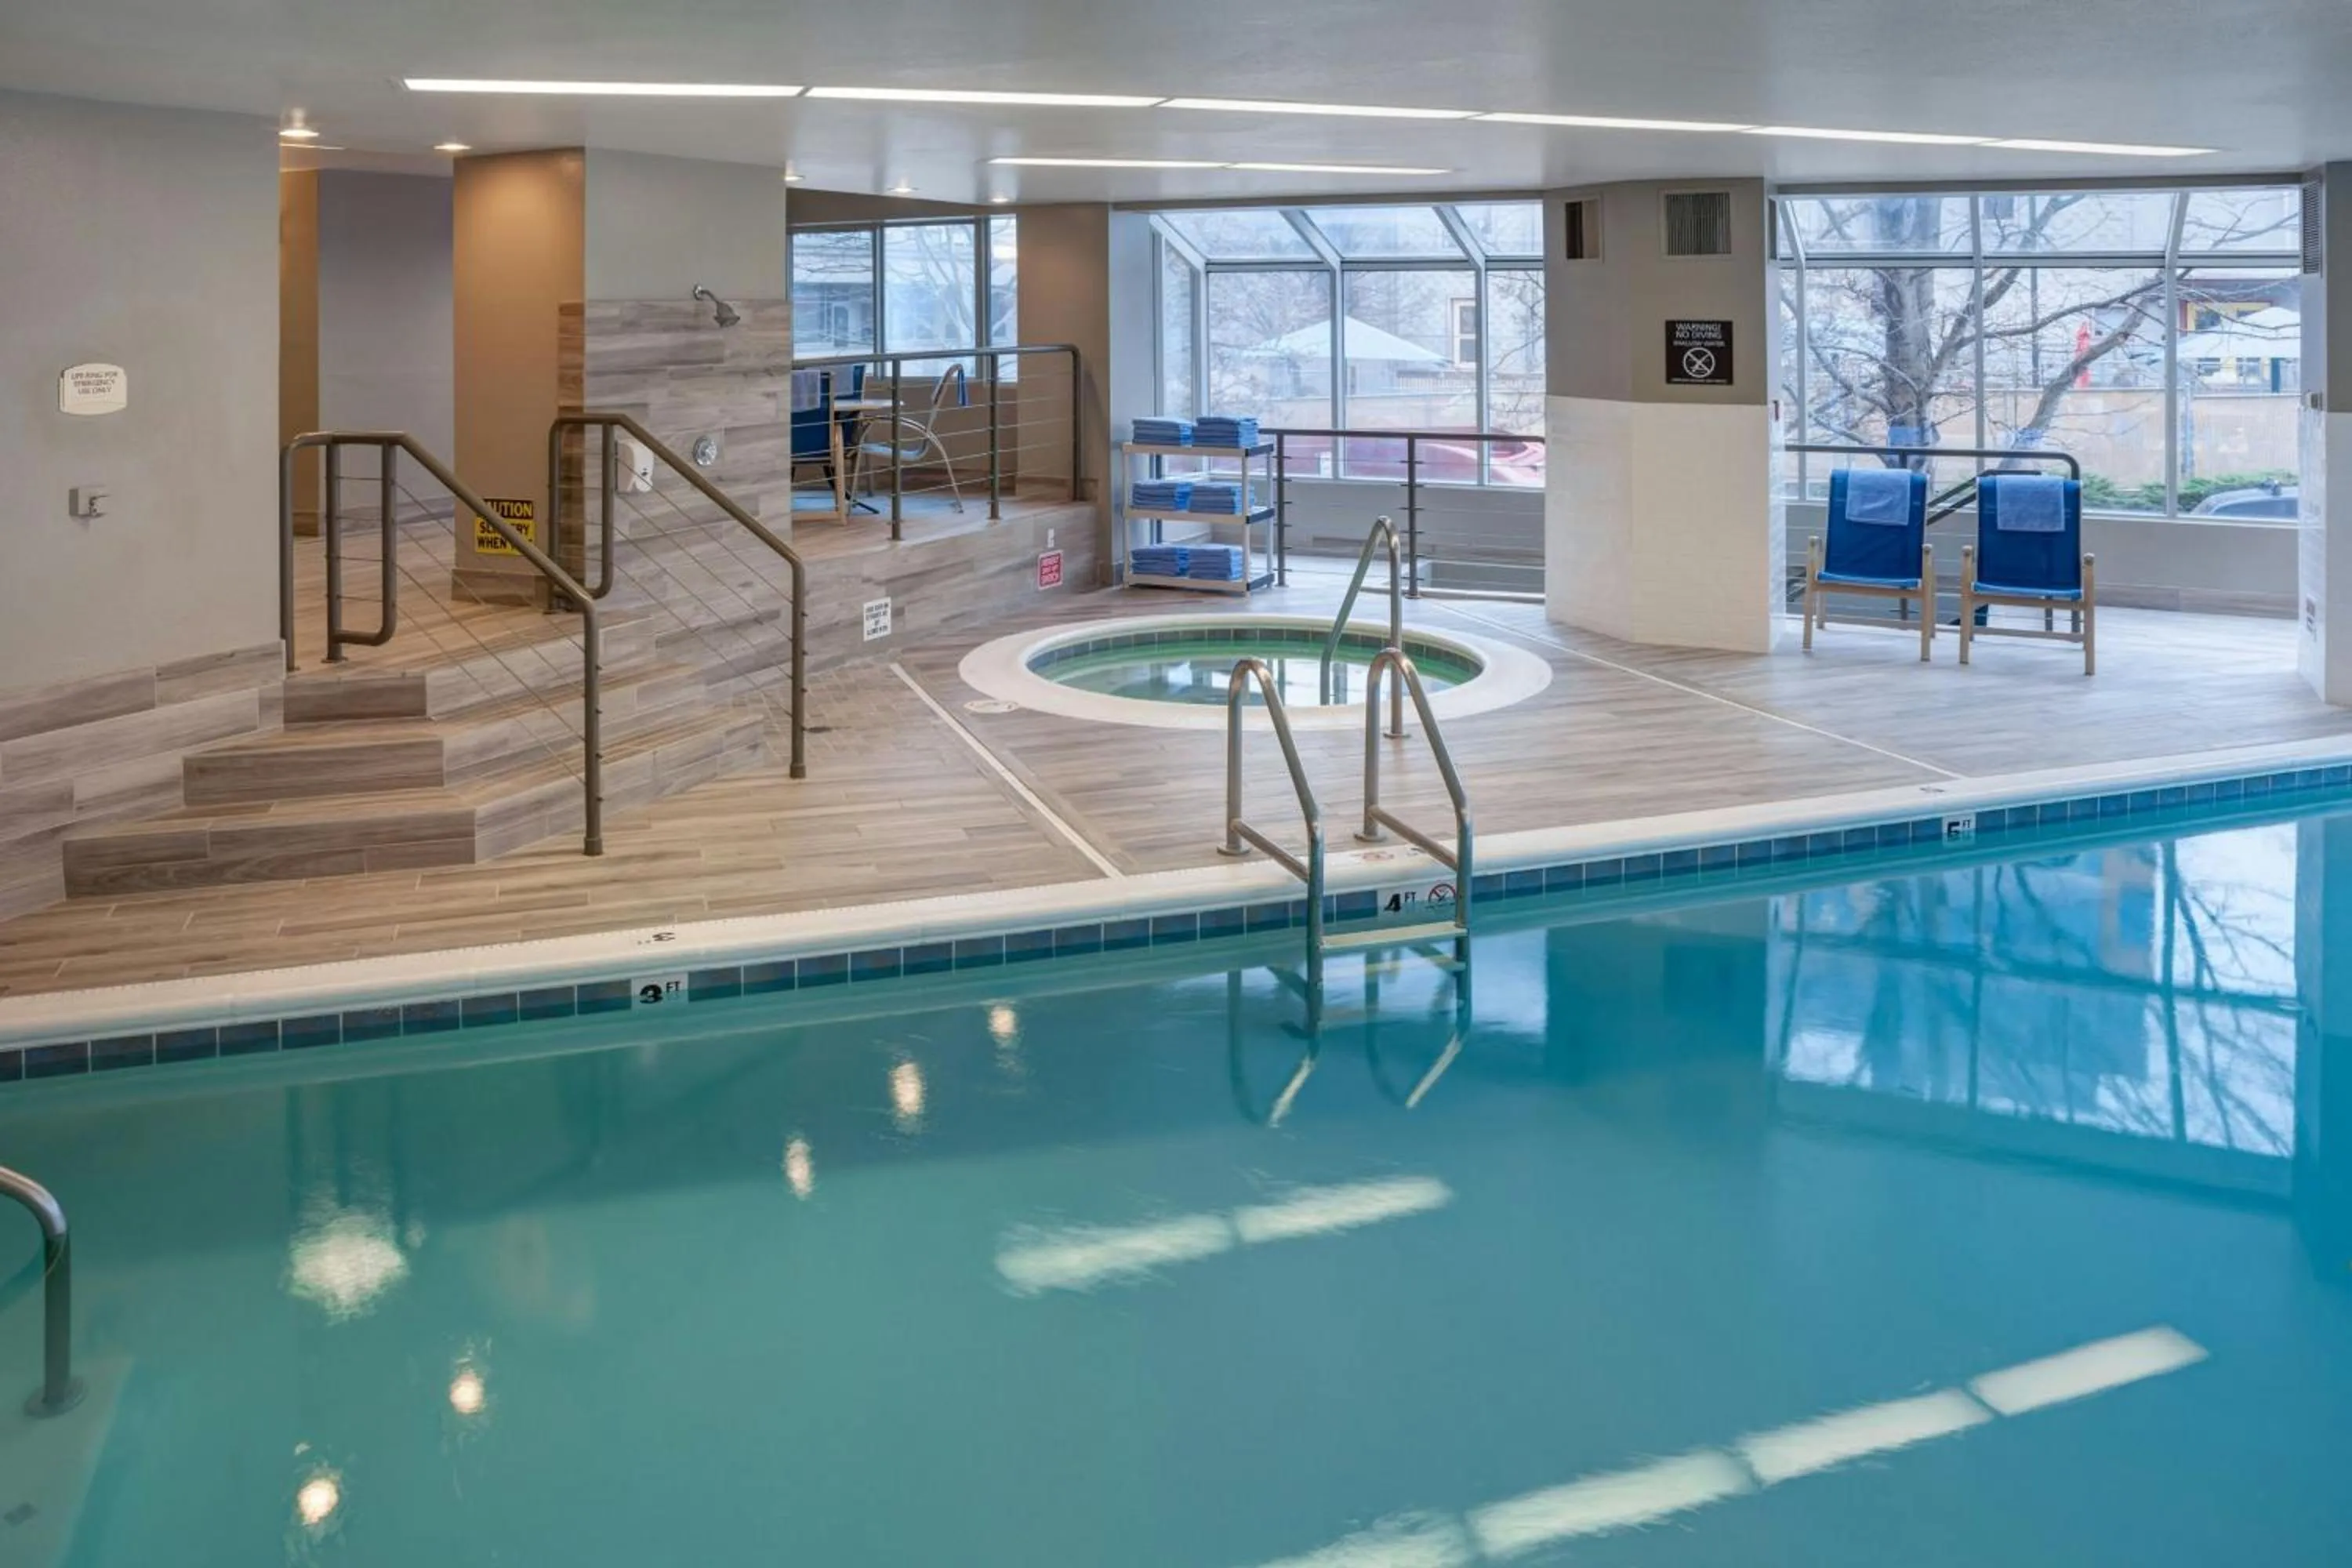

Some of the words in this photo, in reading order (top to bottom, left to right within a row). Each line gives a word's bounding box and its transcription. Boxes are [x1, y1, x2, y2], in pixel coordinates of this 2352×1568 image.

[477, 536, 507, 550] WHEN
[1384, 893, 1401, 913] 4
[1404, 891, 1417, 902] FT
[639, 985, 663, 1004] 3
[666, 981, 681, 993] FT
